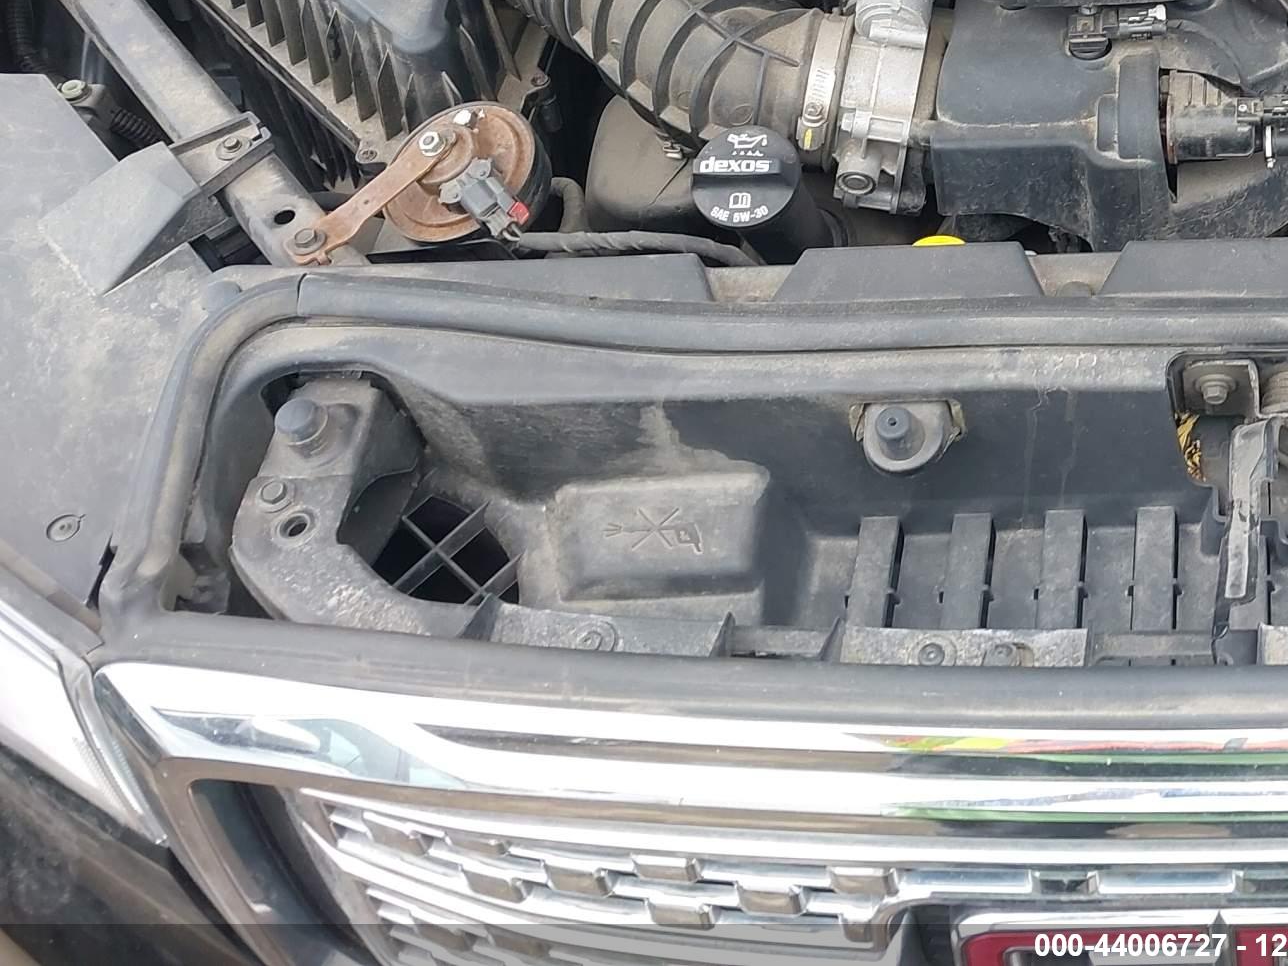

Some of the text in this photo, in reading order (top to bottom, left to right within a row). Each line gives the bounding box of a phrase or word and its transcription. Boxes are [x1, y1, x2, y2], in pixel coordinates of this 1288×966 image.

[699, 156, 770, 173] dexos
[710, 205, 769, 223] SAE 5W-30
